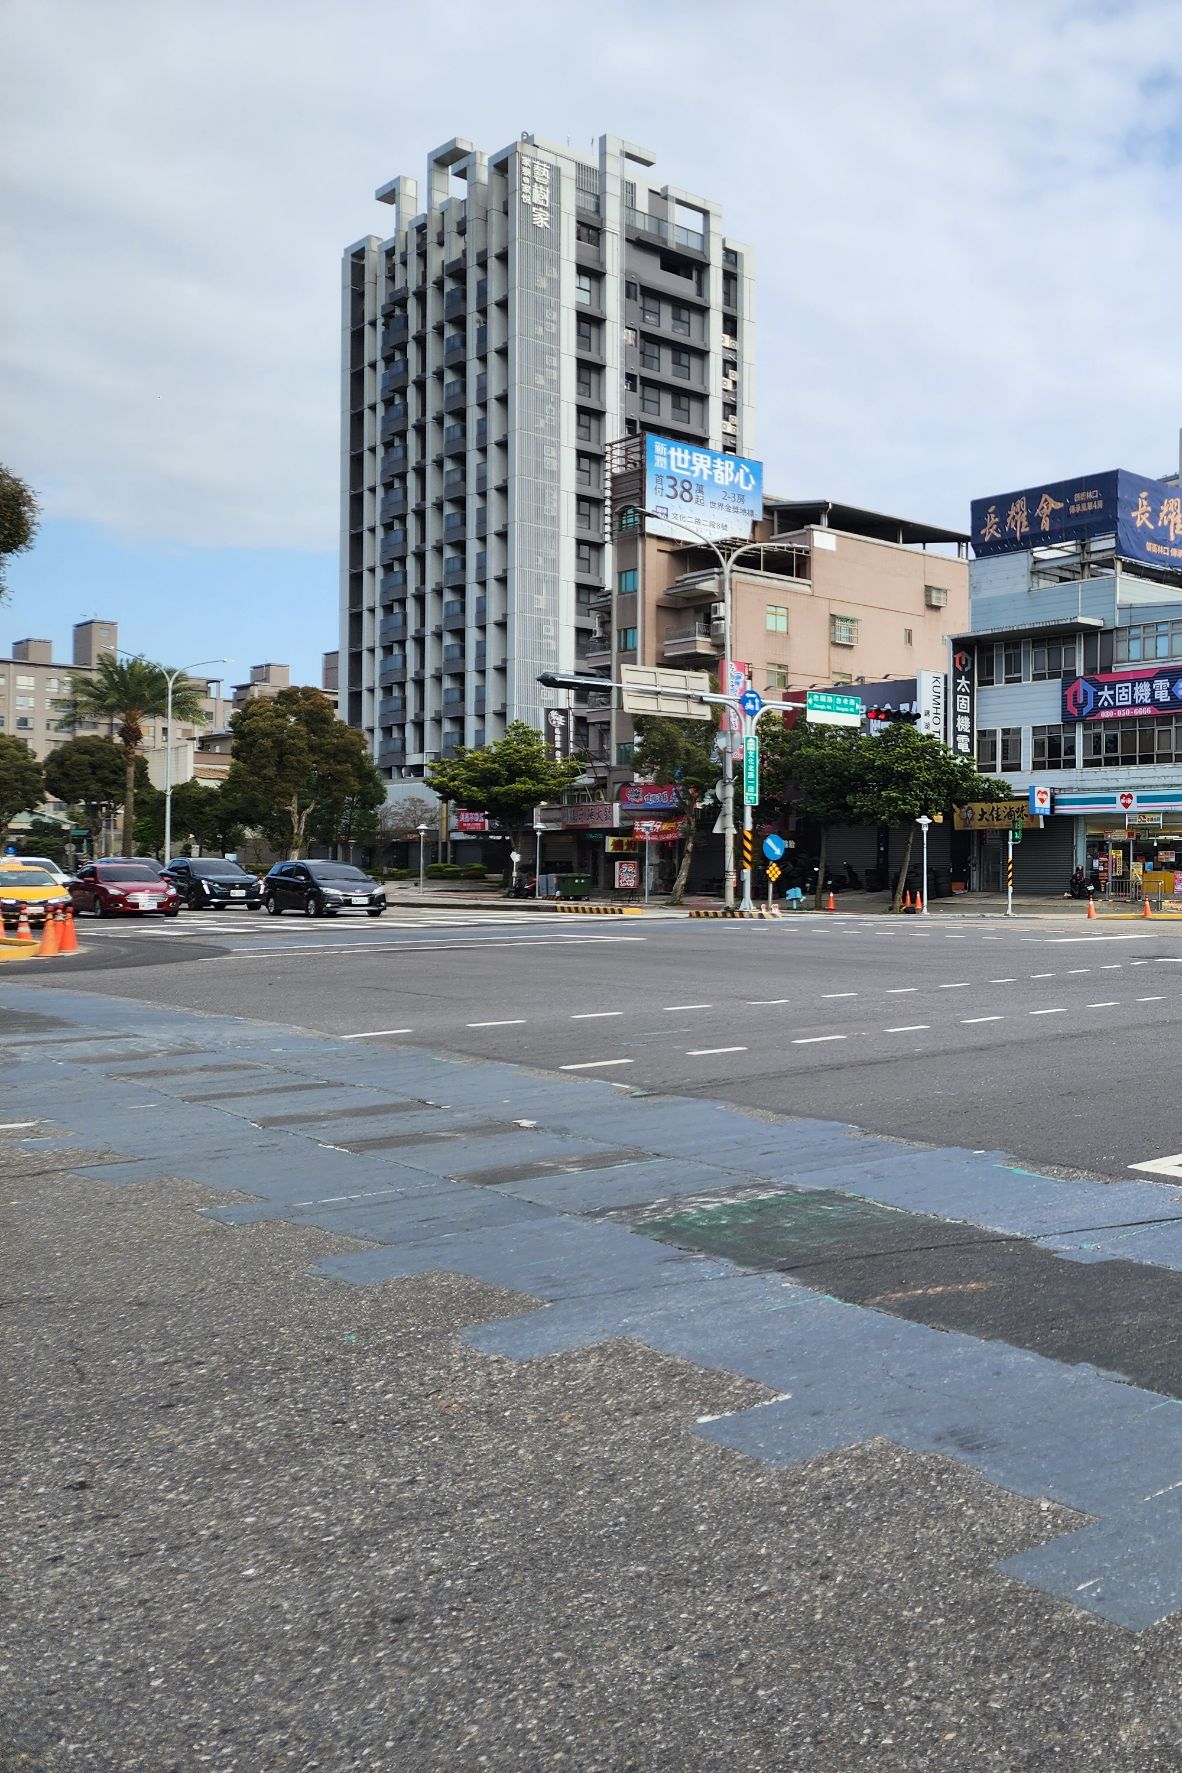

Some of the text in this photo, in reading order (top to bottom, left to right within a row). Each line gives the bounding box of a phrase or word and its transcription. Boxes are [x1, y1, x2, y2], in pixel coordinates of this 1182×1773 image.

[669, 446, 756, 491] 世界都心
[655, 474, 705, 506] 首付 38 萬起
[722, 490, 746, 505] 2-3房
[932, 676, 941, 726] KUMHO
[1098, 679, 1171, 707] 太固機電
[956, 676, 970, 753] 太固機電
